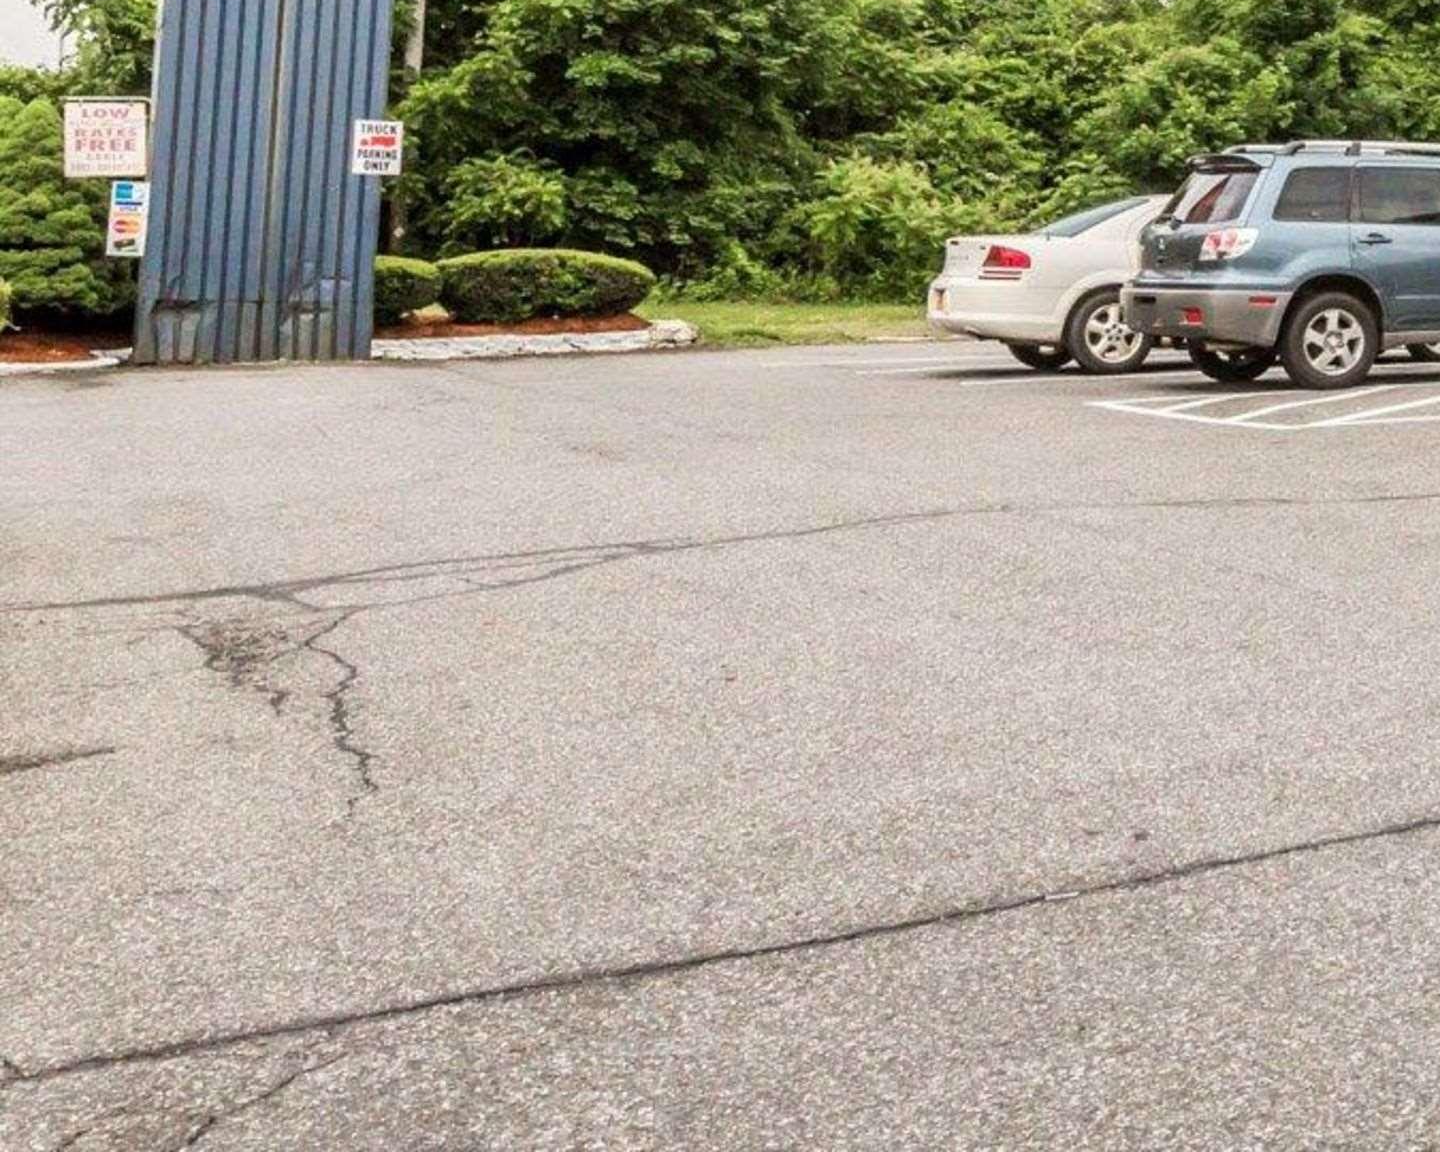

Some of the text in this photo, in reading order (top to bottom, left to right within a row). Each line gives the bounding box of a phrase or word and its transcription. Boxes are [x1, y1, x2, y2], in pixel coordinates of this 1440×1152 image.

[82, 108, 129, 118] LOW
[361, 123, 397, 135] TRUCK
[75, 139, 137, 152] FREE
[356, 148, 398, 161] PARKING
[363, 159, 390, 171] ONLY
